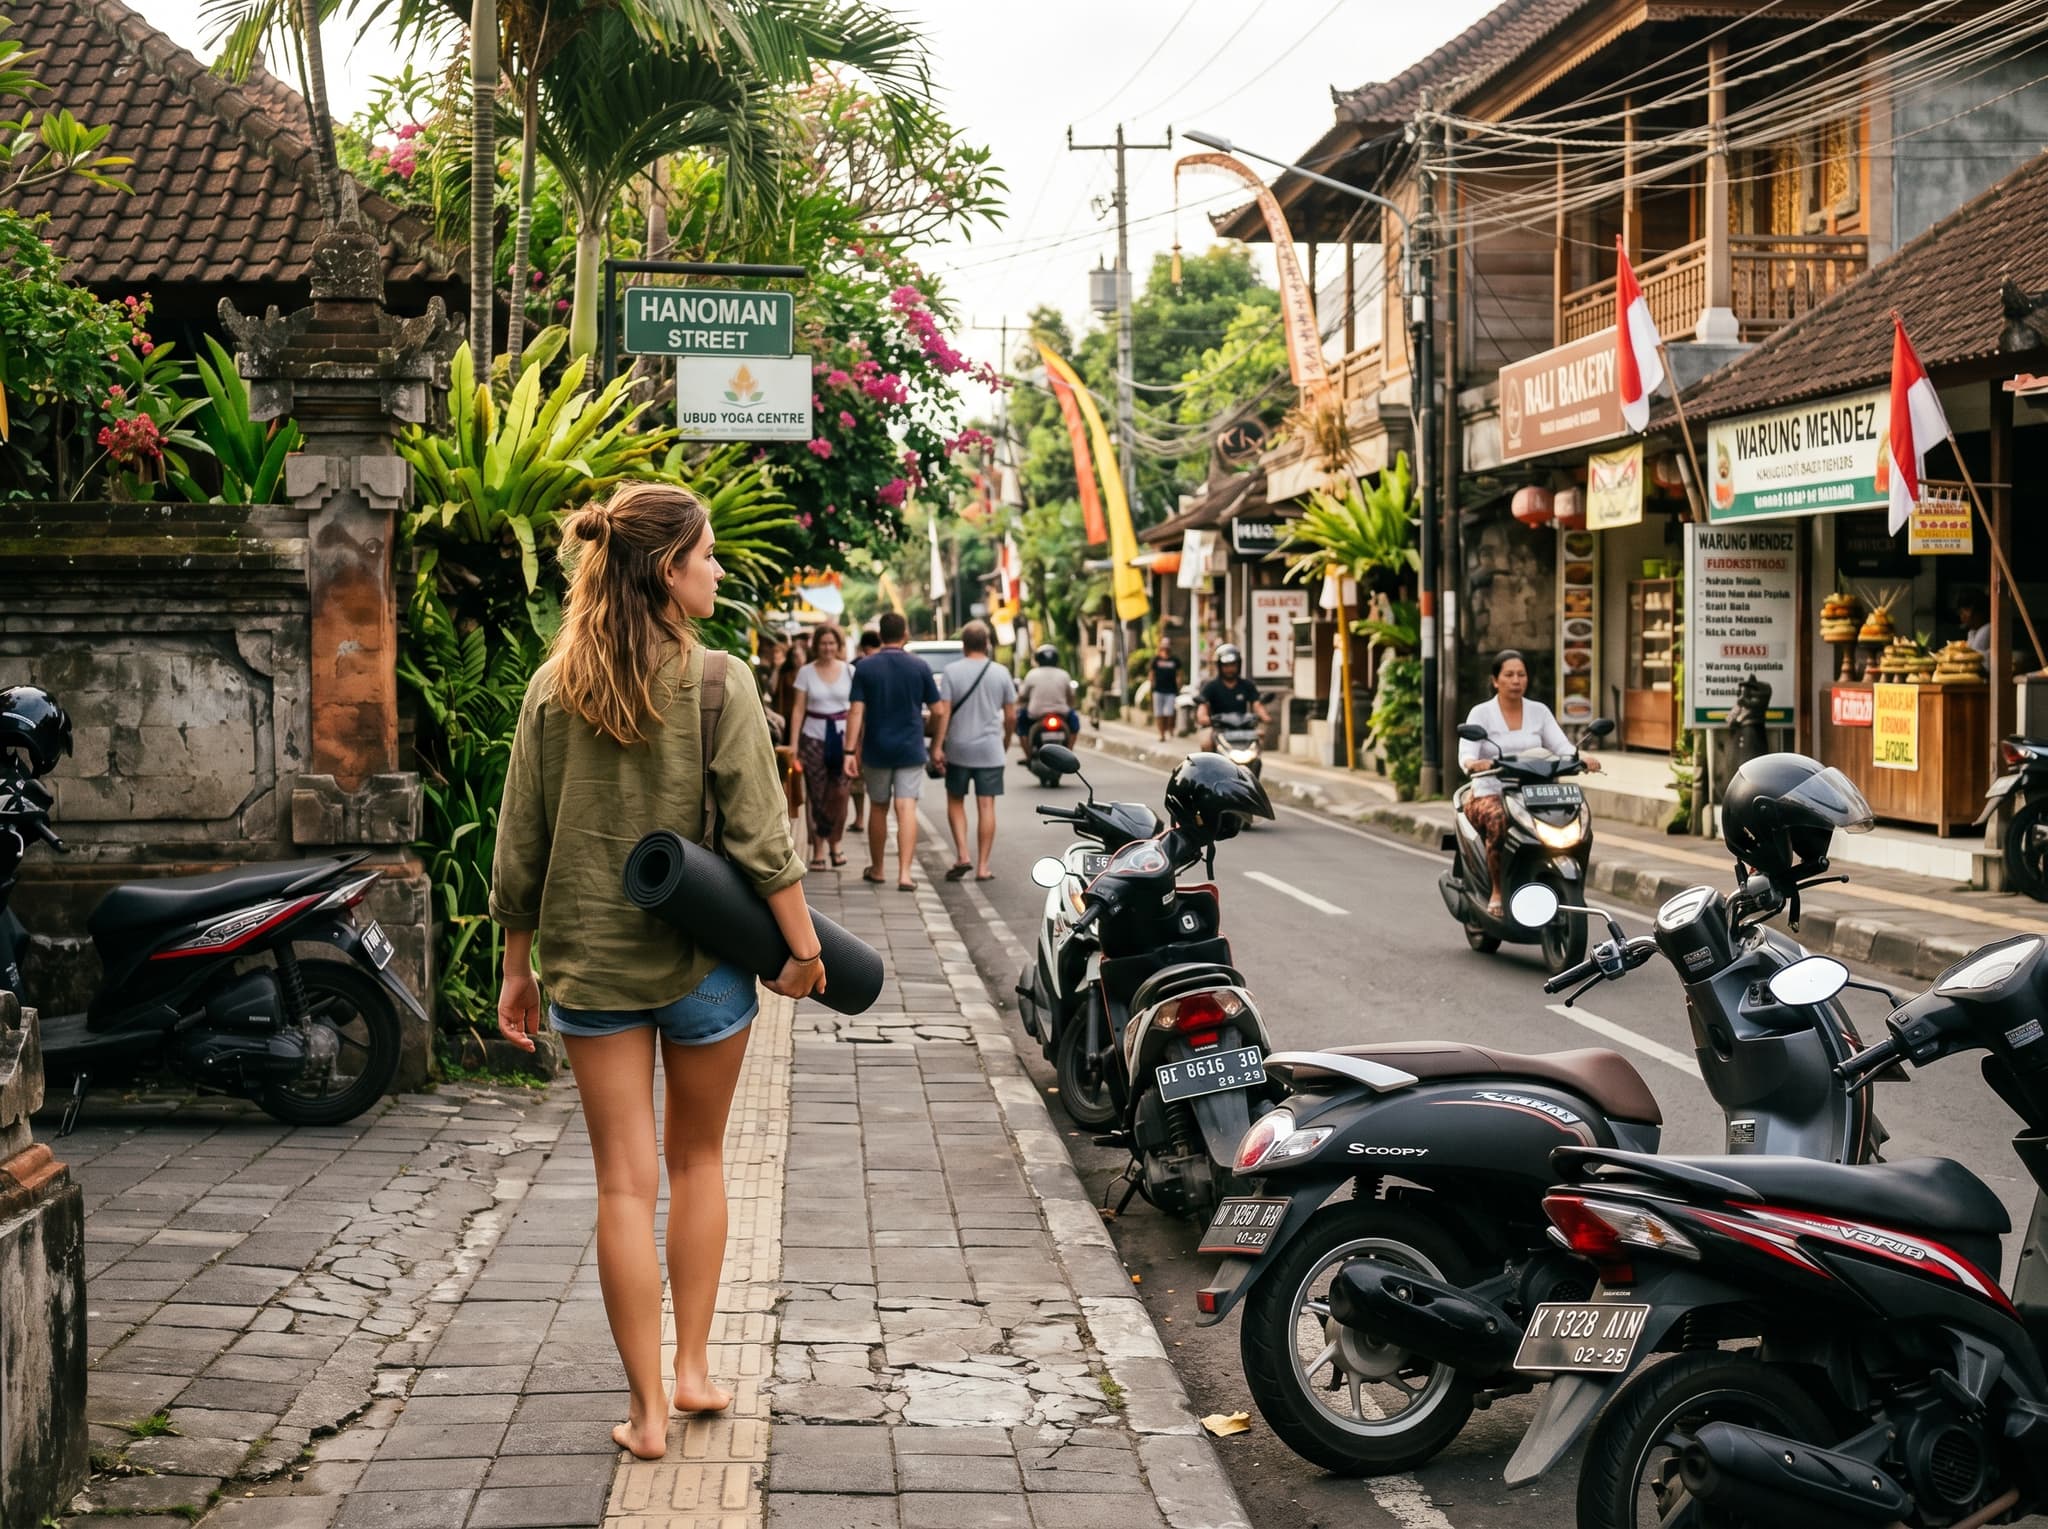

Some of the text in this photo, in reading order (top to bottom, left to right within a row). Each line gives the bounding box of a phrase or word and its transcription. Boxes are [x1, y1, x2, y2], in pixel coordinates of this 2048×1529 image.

[640, 296, 777, 325] HANOMAN
[667, 329, 749, 349] STREET
[1557, 348, 1616, 407] BAKERY
[683, 412, 805, 424] UBUD YOGA CENTRE
[1735, 402, 1877, 461] WARUNG MENDEZ
[1699, 532, 1793, 551] WARUNG MENDEZ
[1235, 1231, 1267, 1245] 10-22
[1530, 1309, 1549, 1337] K
[1552, 1309, 1599, 1337] 1328
[1574, 1346, 1627, 1364] 02-25
